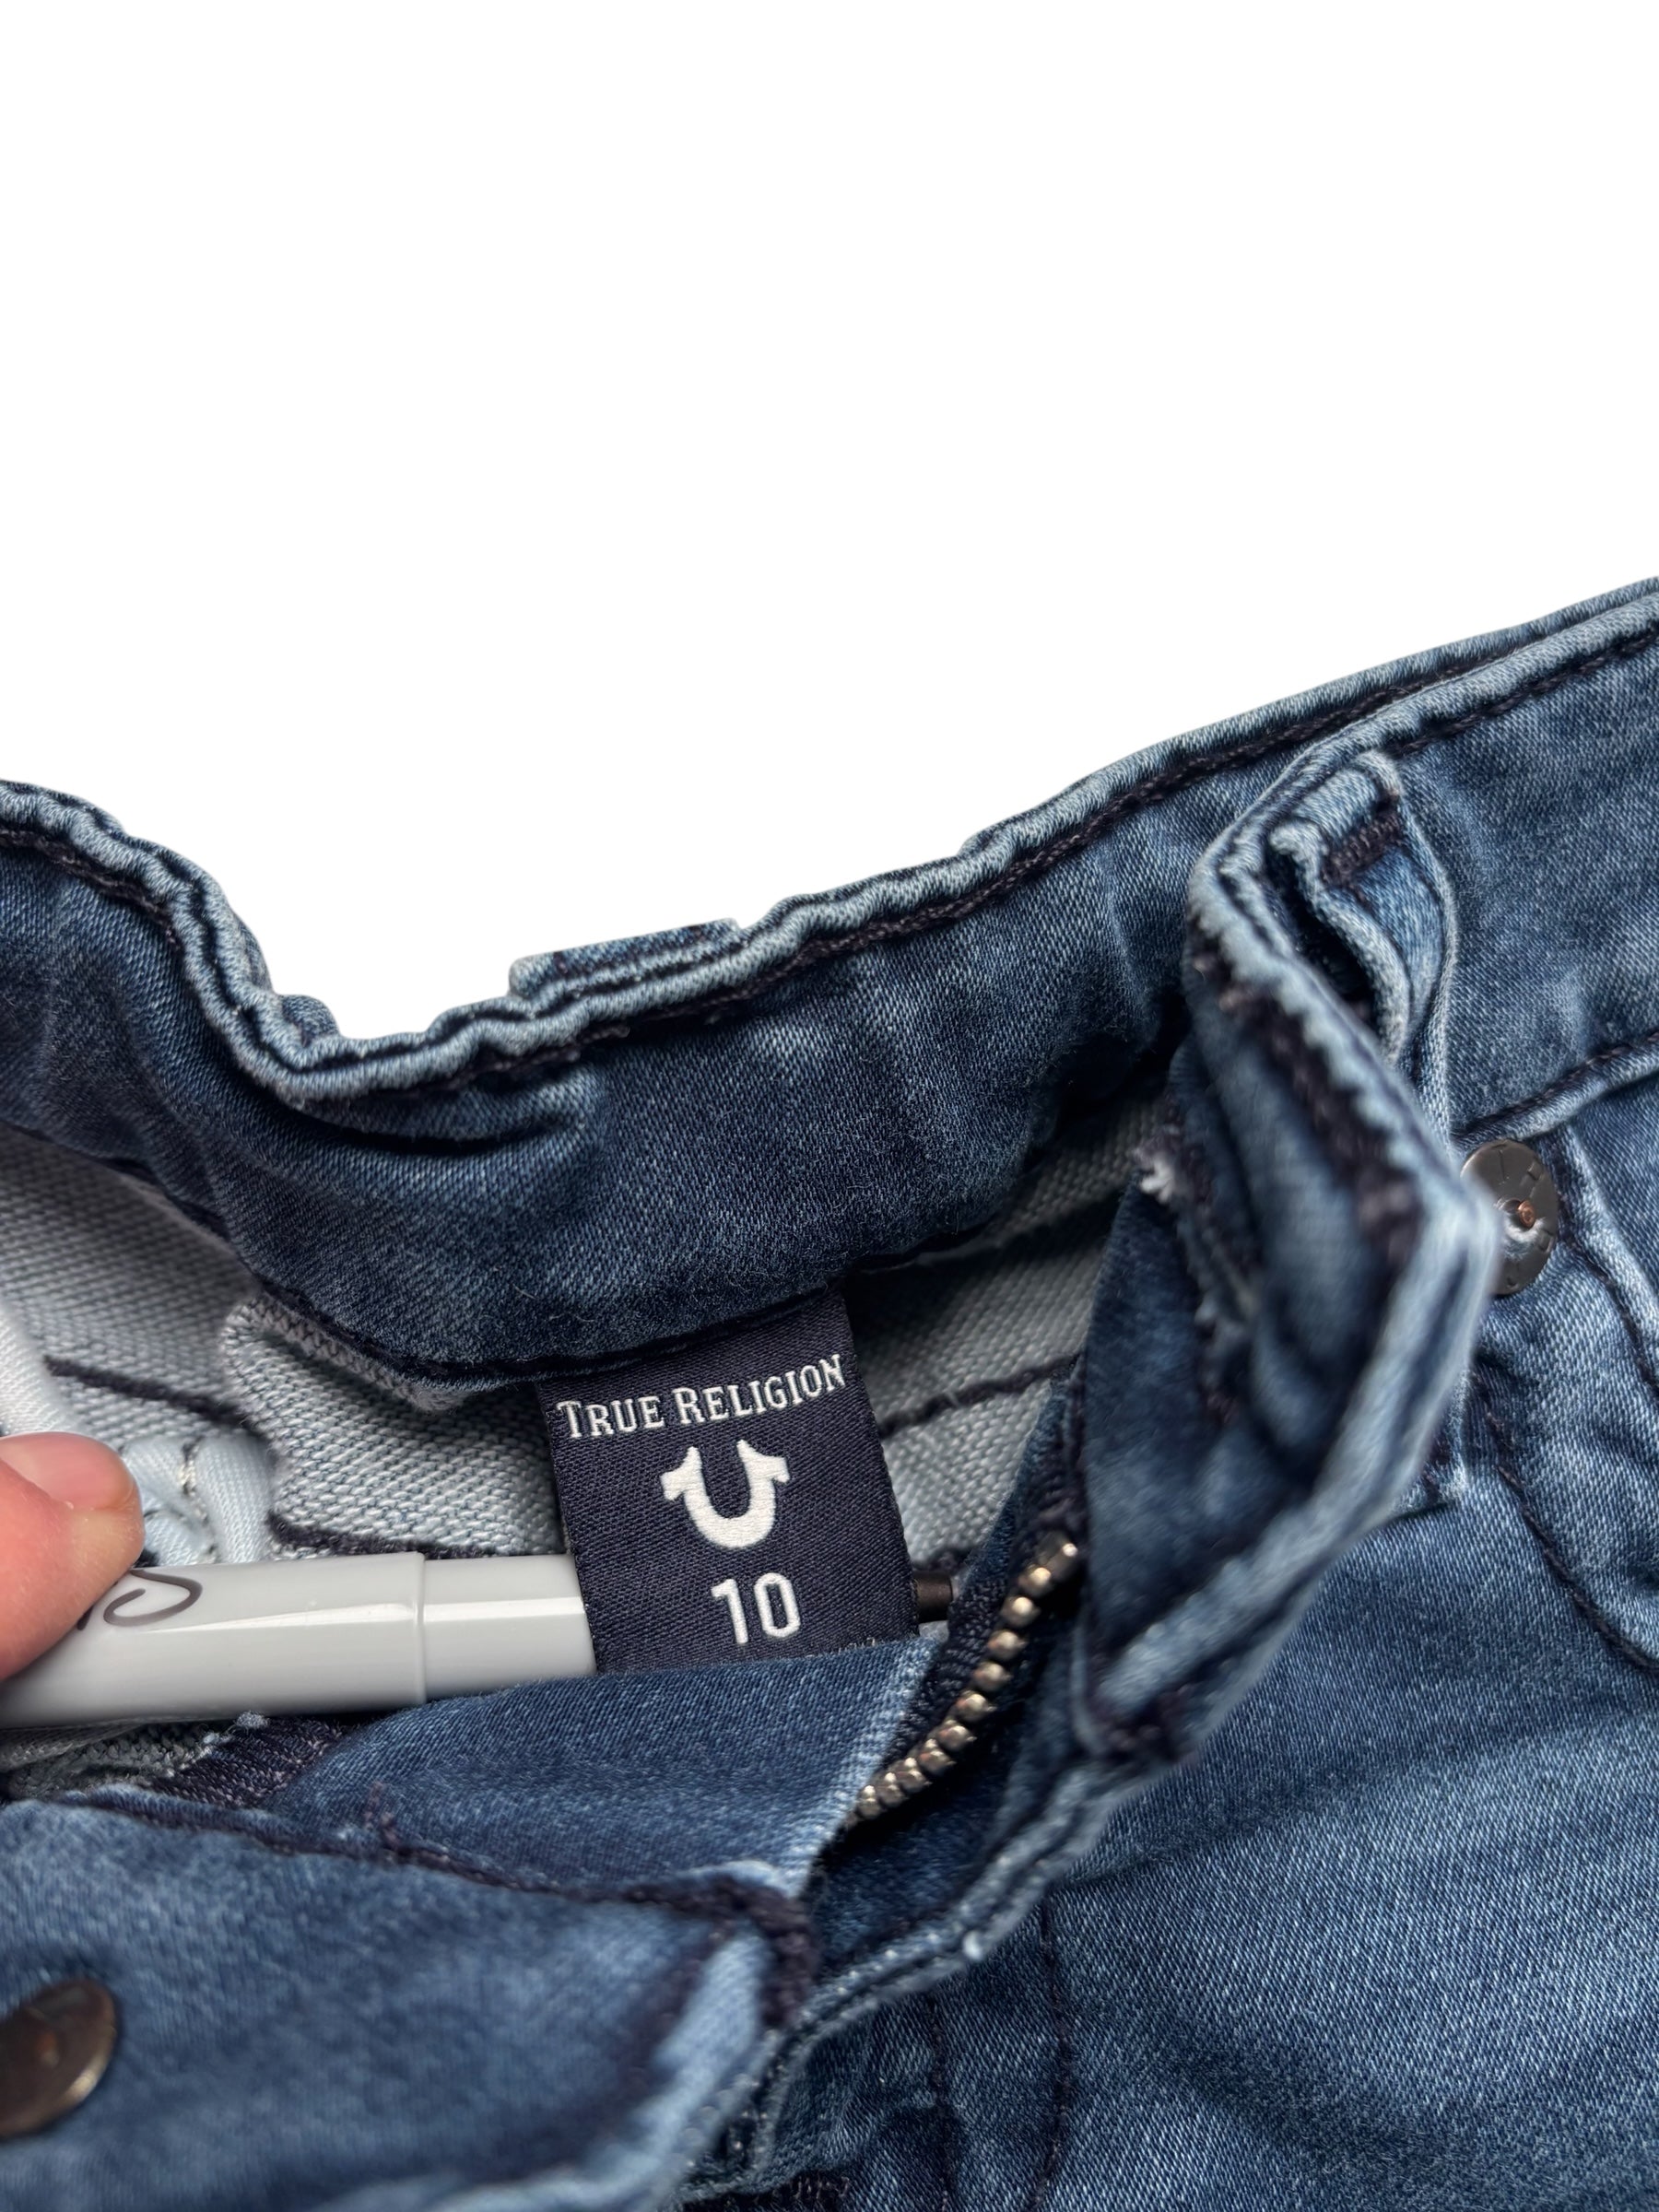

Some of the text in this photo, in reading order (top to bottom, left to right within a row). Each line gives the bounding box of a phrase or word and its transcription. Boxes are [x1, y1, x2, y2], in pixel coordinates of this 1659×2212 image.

[557, 1354, 846, 1439] TRUE RELIGION
[711, 1571, 802, 1645] 10
